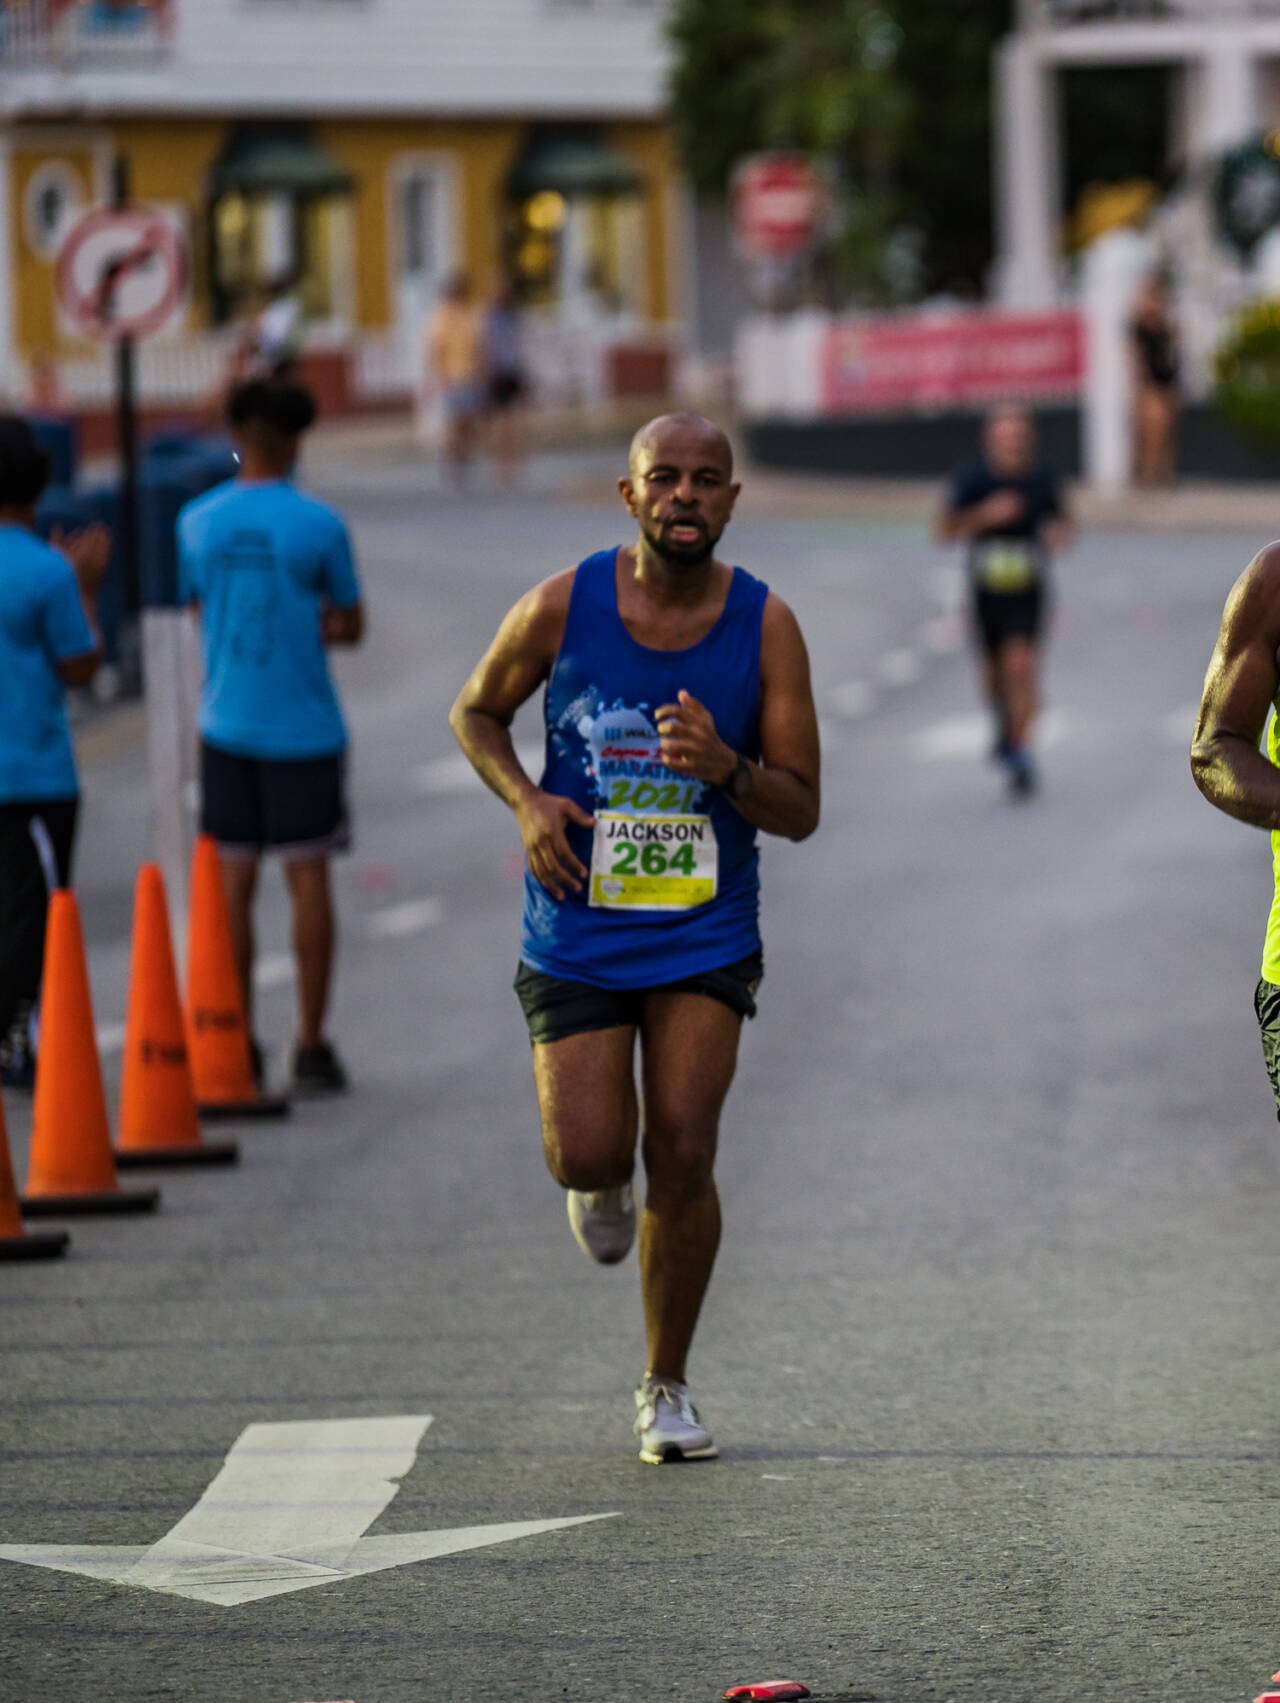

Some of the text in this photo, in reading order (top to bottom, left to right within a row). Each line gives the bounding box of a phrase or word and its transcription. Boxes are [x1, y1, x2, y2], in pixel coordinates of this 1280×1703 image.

[608, 780, 695, 815] 2021
[606, 821, 704, 841] JACKSON
[611, 842, 697, 876] 264
